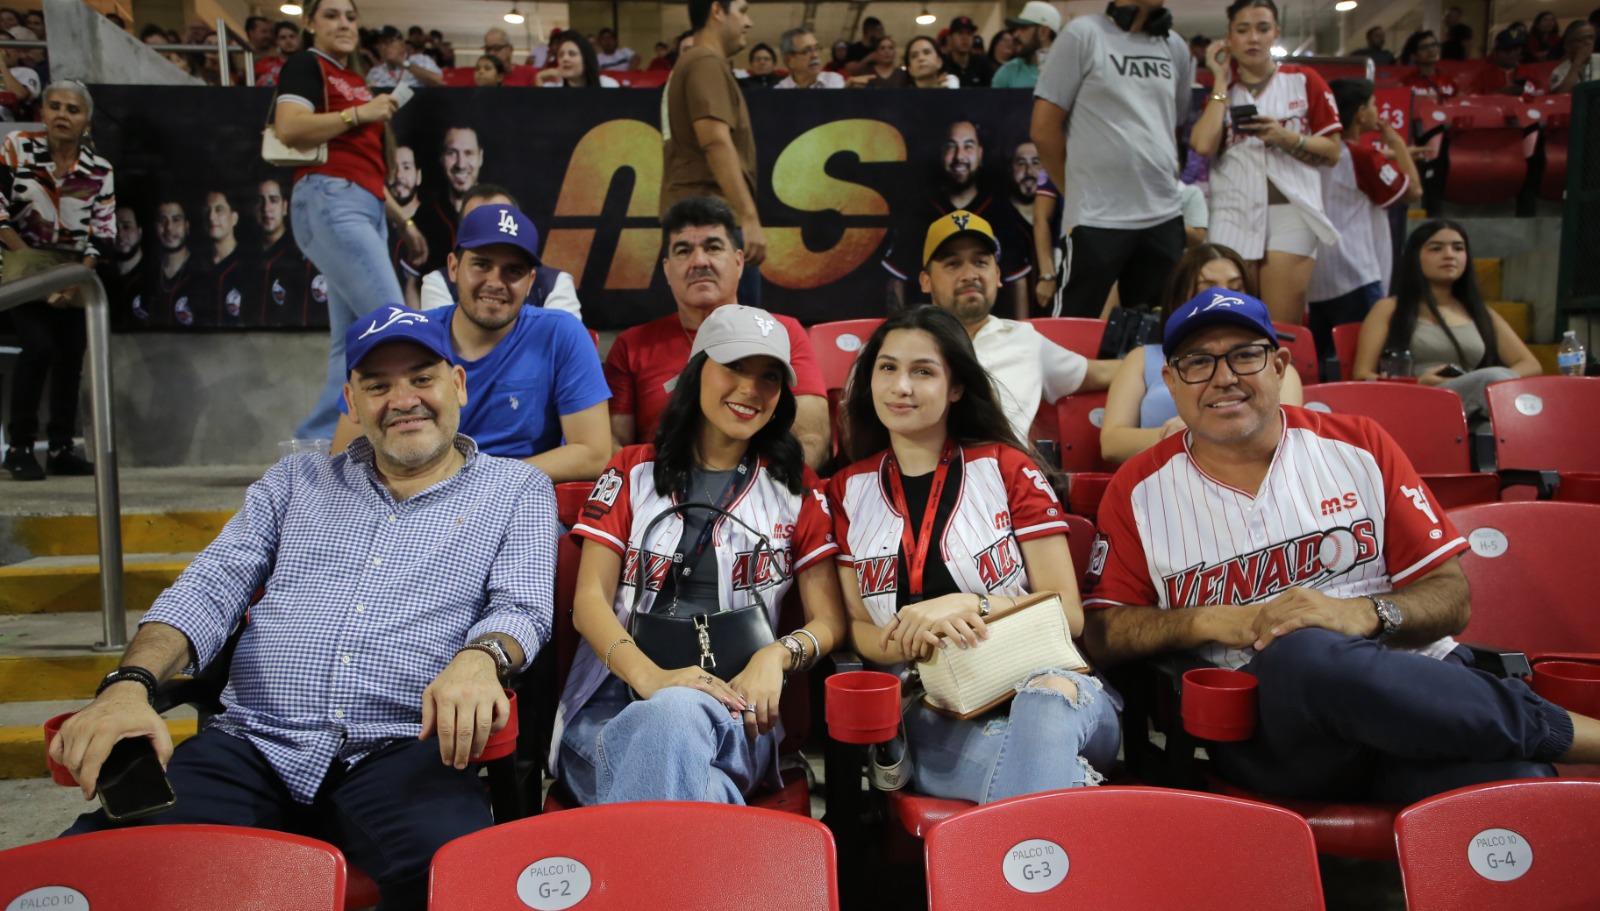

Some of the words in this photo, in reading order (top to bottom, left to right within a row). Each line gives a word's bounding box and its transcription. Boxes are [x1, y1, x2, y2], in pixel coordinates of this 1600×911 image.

[1109, 54, 1171, 79] VANS
[498, 209, 518, 237] LA
[1476, 836, 1506, 848] PALCO
[1507, 834, 1517, 845] 10
[1012, 847, 1043, 861] PALCO
[1044, 845, 1055, 855] 10
[1486, 851, 1517, 869] G-4
[530, 865, 564, 877] PALCO
[566, 863, 577, 873] 10
[1022, 861, 1052, 880] G-3
[538, 880, 572, 898] G-2
[20, 896, 60, 910] PALCO
[63, 894, 75, 905] 10
